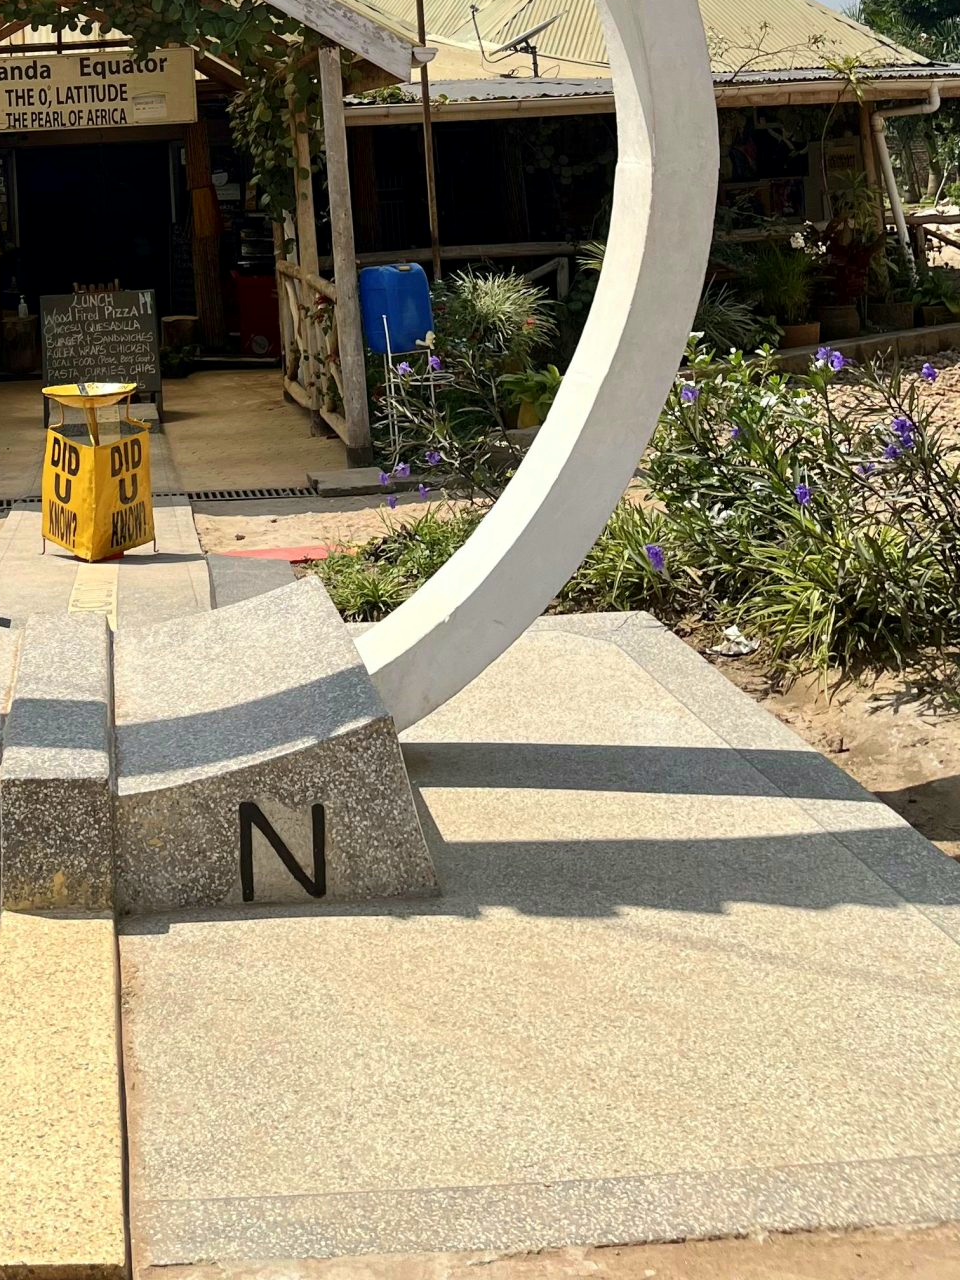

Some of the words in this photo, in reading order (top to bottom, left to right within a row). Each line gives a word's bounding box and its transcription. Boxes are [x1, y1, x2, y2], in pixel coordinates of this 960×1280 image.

[80, 57, 168, 80] Equator
[5, 88, 35, 107] THE
[56, 83, 128, 105] LATITUDE
[6, 112, 29, 129] THE
[31, 110, 66, 128] PEARL
[68, 109, 84, 127] OF
[86, 108, 128, 126] AFRICA
[71, 293, 114, 308] LUNCH
[44, 307, 73, 325] Wood
[75, 307, 100, 321] Fired
[85, 320, 140, 333] QUESADILLA
[93, 332, 154, 344] SANDWICHES
[109, 344, 150, 354] CHICKEN
[73, 356, 96, 367] FOOD
[129, 364, 156, 375] CHIPS
[51, 436, 80, 477] DID
[111, 437, 142, 478] DID
[54, 473, 72, 505] U
[118, 473, 137, 505] U
[48, 499, 78, 549] KNOW?
[111, 500, 147, 549] KNOW?
[240, 801, 326, 902] N
